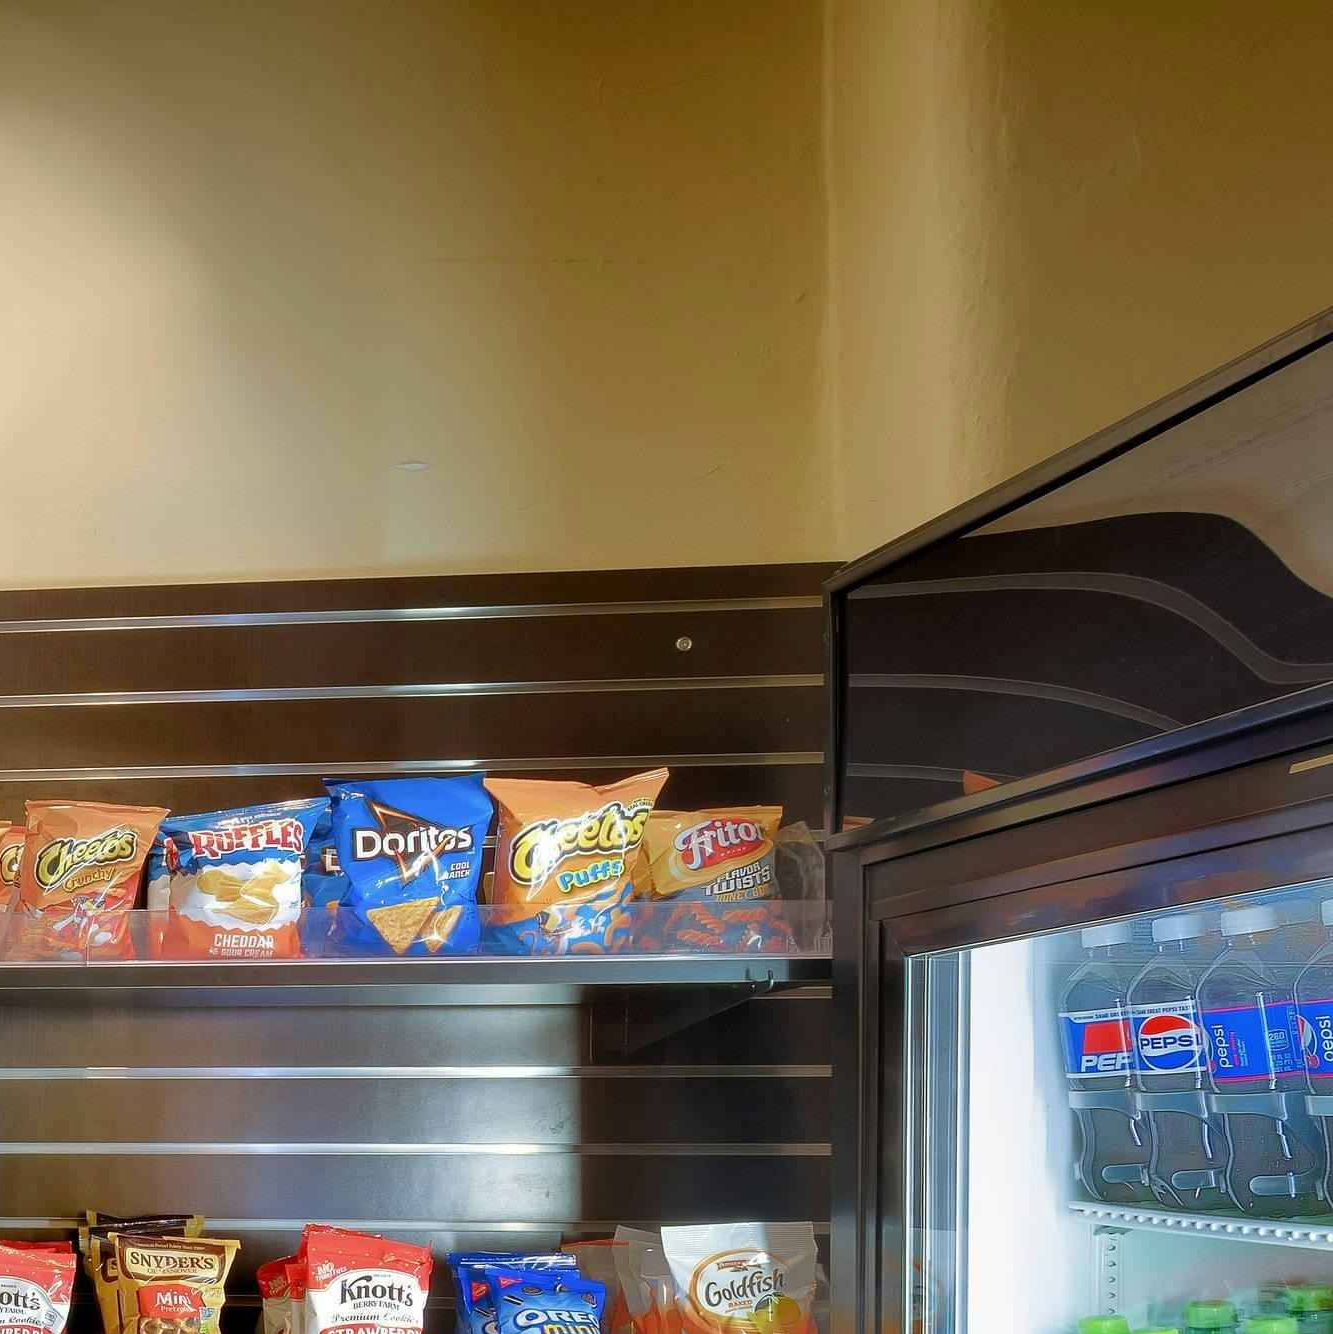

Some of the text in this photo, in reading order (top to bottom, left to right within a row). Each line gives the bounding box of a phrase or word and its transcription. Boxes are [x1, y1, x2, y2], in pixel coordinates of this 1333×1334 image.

[189, 819, 304, 859] RUFFLES
[355, 828, 472, 860] Doritos
[509, 803, 651, 886] Cheetos
[36, 830, 138, 884] Cheetos
[449, 861, 470, 870] COOL
[62, 866, 116, 893] Crunchy
[558, 859, 624, 892] Puffs
[701, 866, 771, 896] TWISTS
[716, 862, 761, 884] FLAVOR
[214, 934, 274, 949] CHEDDAR
[1140, 1033, 1203, 1051] PEPSI
[1210, 1024, 1232, 1069] pepsi
[129, 1250, 215, 1270] SNYDER'S
[155, 1291, 191, 1307] Mini
[340, 1275, 413, 1307] Knott's
[353, 1301, 377, 1310] BERRY
[728, 1299, 753, 1308] BAKED
[331, 1312, 380, 1324] Premium
